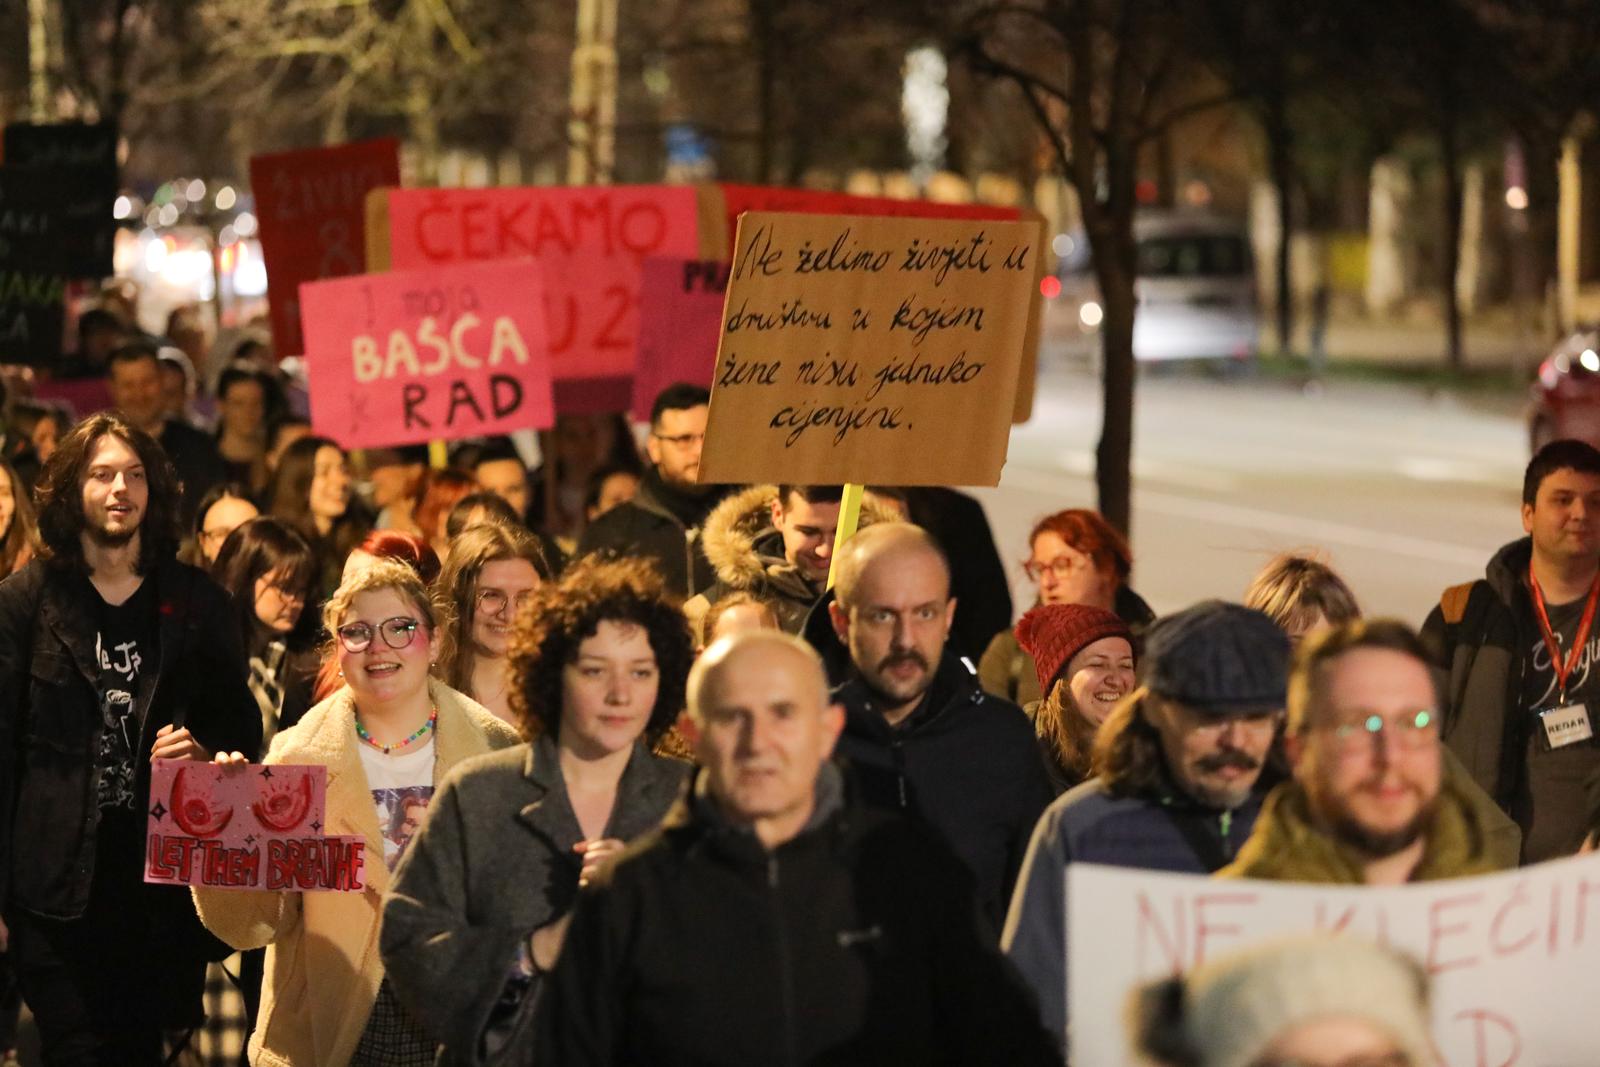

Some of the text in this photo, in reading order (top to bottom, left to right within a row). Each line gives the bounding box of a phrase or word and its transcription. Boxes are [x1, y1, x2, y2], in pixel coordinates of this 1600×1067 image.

[415, 190, 668, 264] ČEKAMO
[736, 223, 1030, 287] Ne želimo živjeti u
[726, 294, 984, 346] društvu u kojem
[718, 353, 782, 388] žene
[798, 352, 859, 387] nisu
[403, 373, 523, 430] RAD
[769, 402, 914, 448] cijenjene.
[149, 834, 365, 892] LET THEM BREATHE
